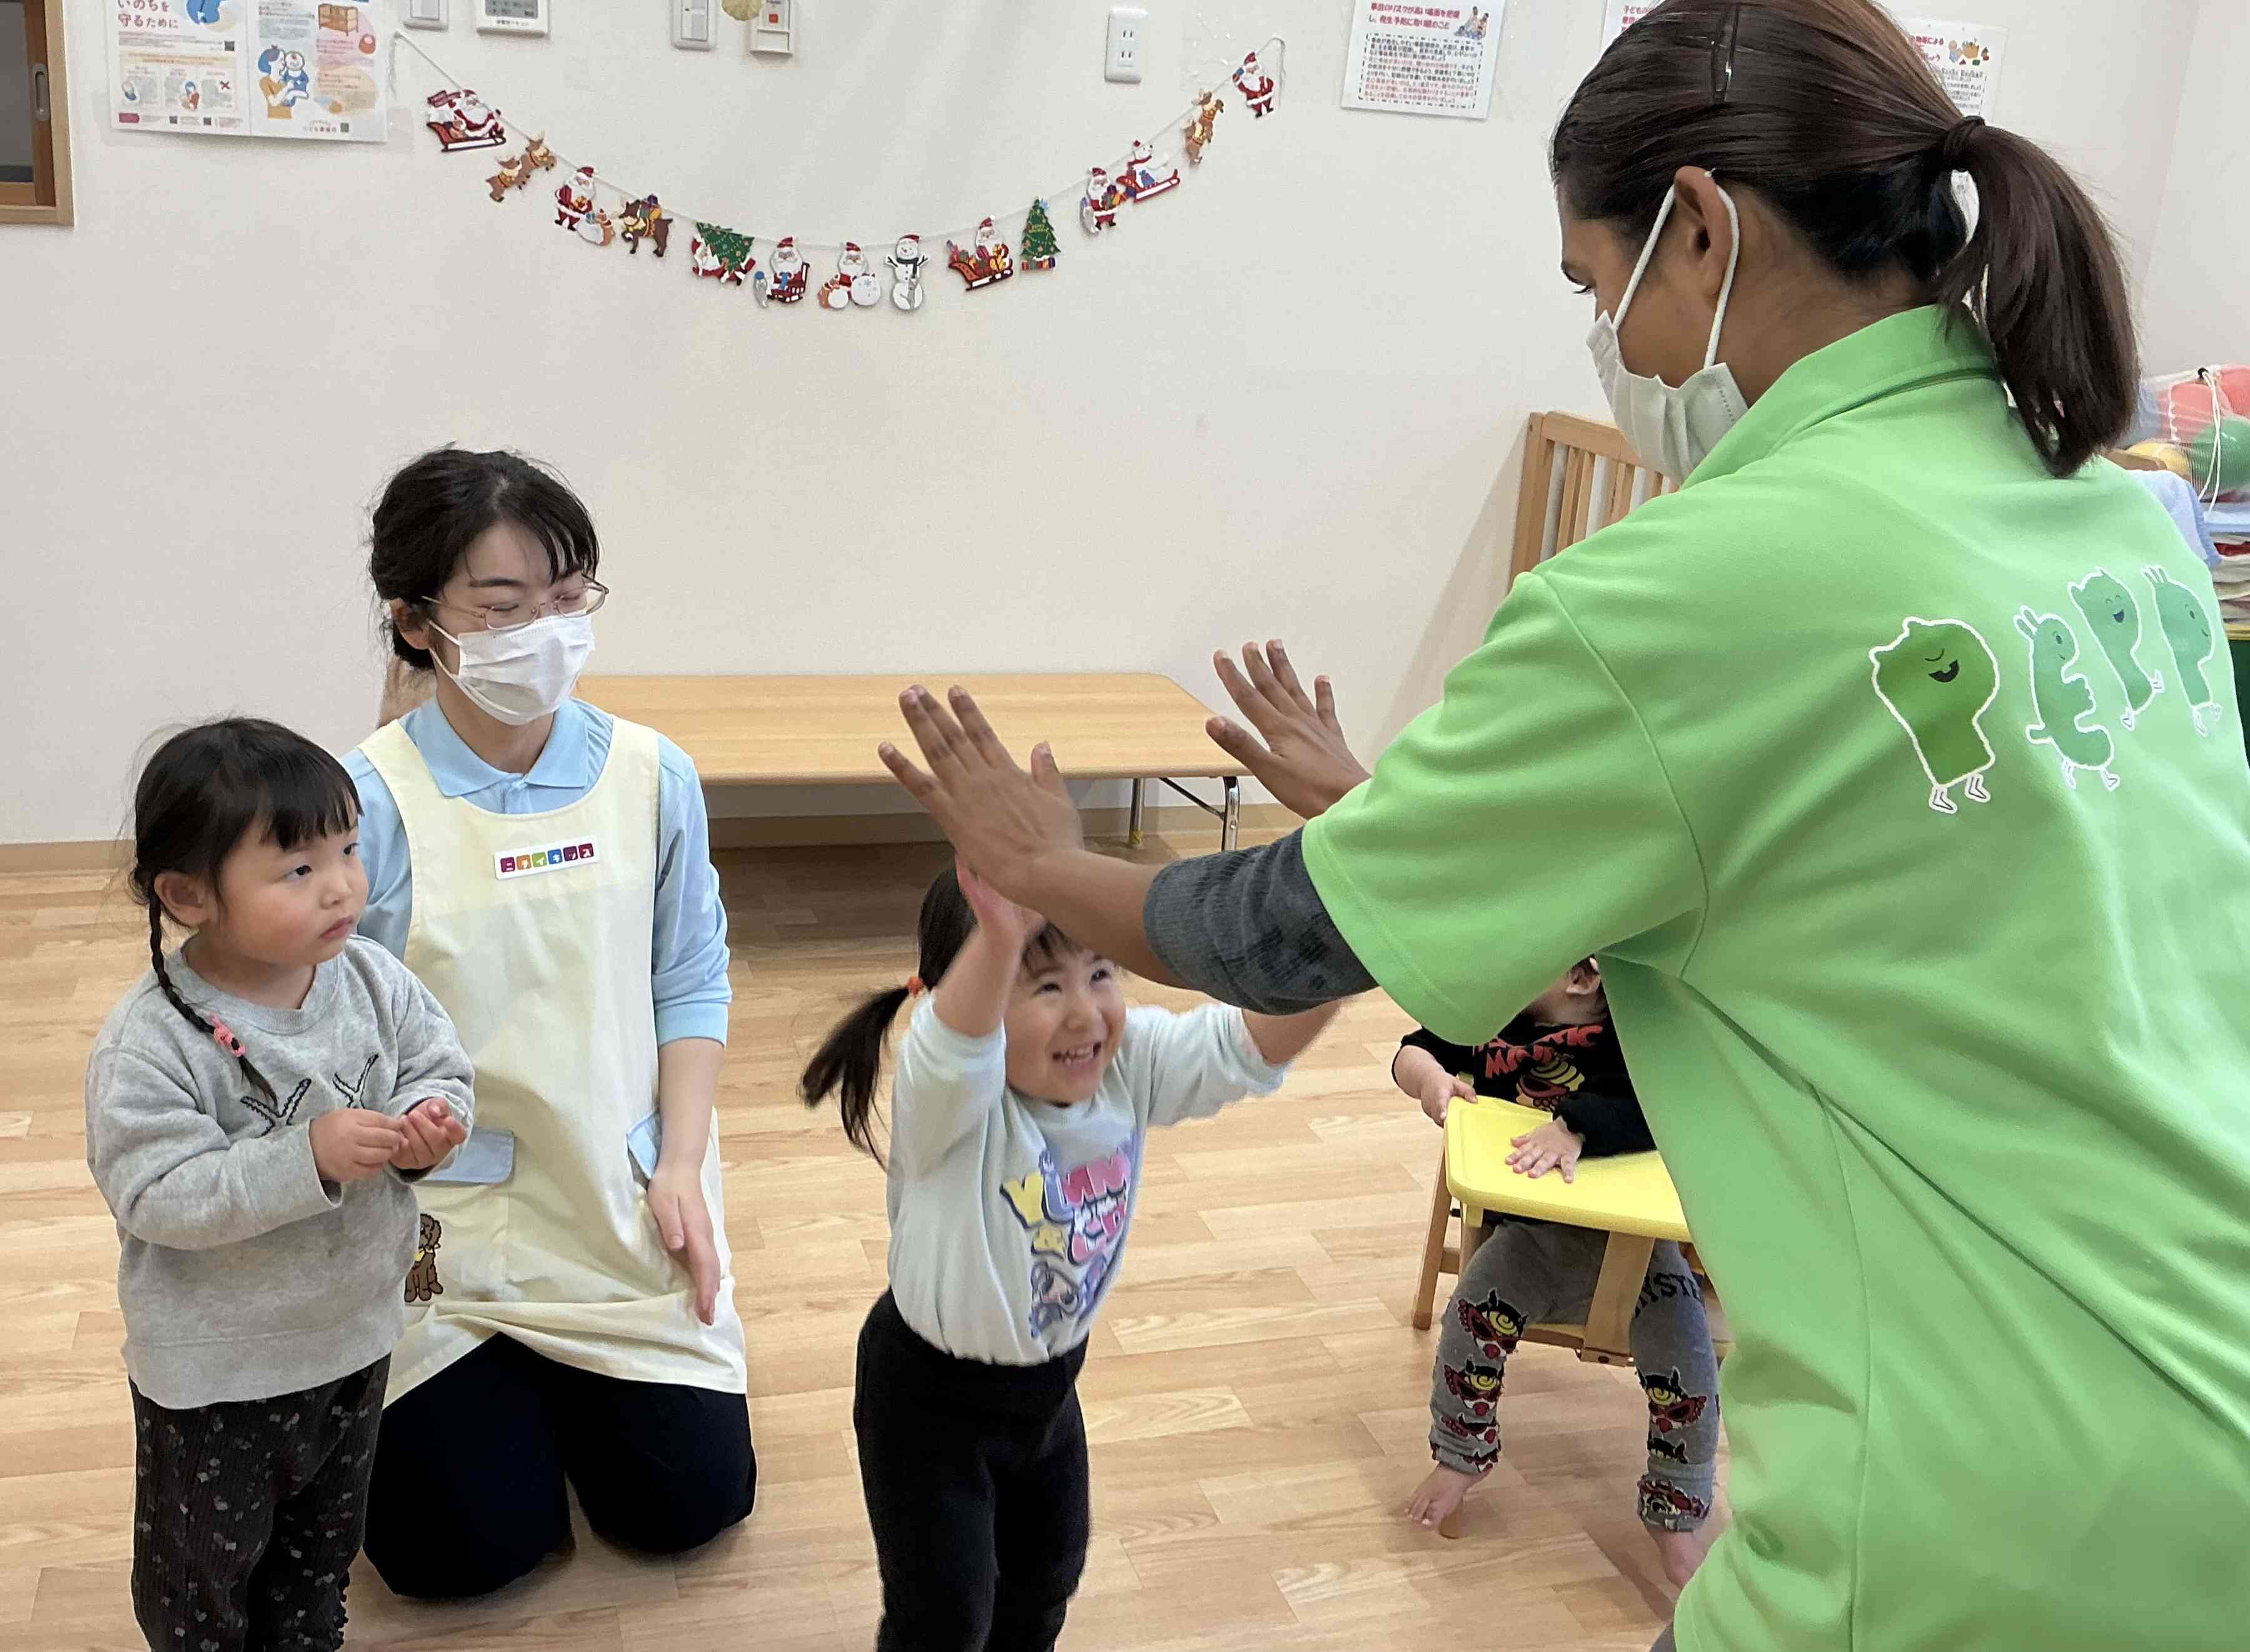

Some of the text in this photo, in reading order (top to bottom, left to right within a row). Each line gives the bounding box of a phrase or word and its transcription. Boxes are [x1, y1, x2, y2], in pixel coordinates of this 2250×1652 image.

[118, 0, 169, 12] いのちを
[118, 13, 179, 29] 守るために
